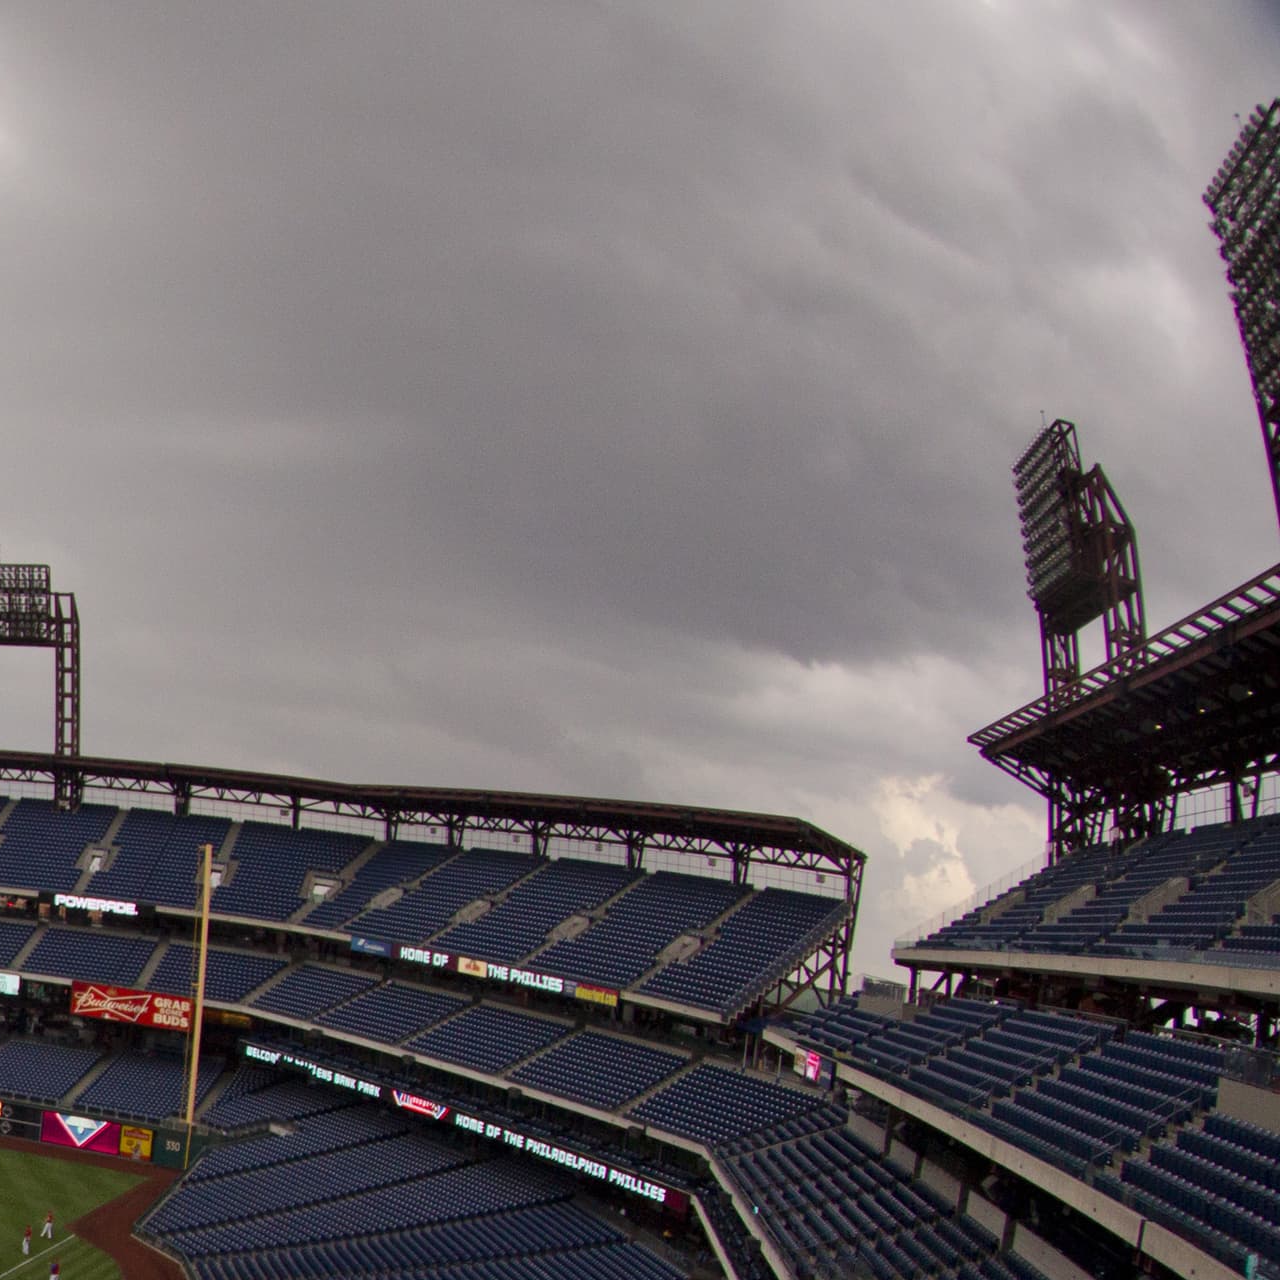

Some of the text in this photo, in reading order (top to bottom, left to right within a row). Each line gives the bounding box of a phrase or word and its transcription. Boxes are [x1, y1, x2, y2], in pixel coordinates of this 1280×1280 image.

[401, 946, 448, 967] HOME OF
[487, 963, 564, 993] THE PHILLIES
[75, 991, 148, 1014] Budweiser
[154, 997, 190, 1011] GRAB
[153, 1013, 189, 1028] BUDS
[333, 1072, 356, 1089] BANK
[358, 1080, 381, 1098] PARK
[166, 1140, 180, 1152] 330
[456, 1113, 666, 1202] HOME OF THE PHILADELPHIA PHILLIES
